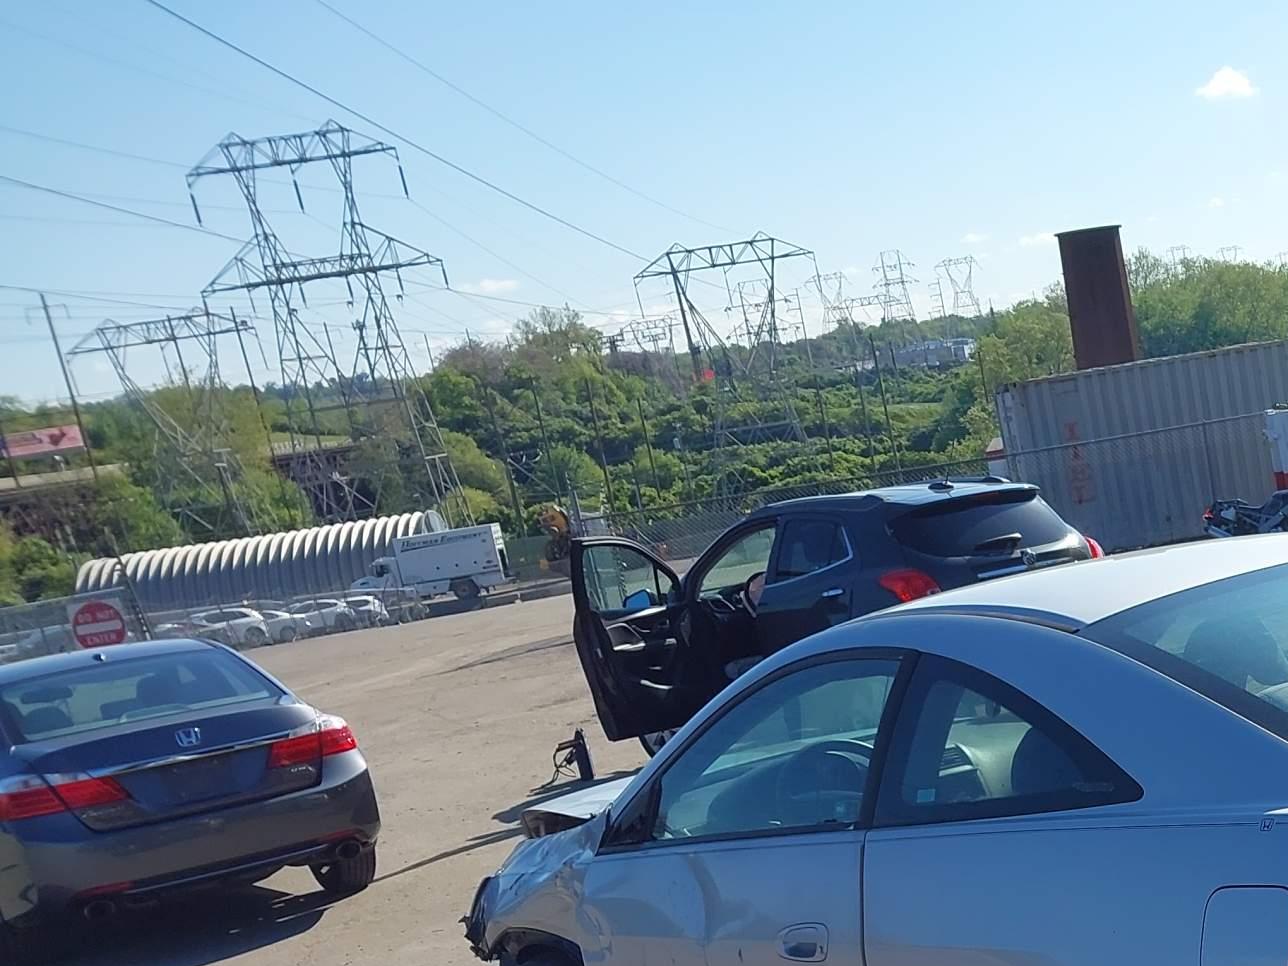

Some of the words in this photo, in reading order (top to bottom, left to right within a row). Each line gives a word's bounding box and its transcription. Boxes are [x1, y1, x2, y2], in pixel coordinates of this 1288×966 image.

[77, 613, 92, 623] DO
[96, 609, 114, 619] NOT
[87, 632, 117, 646] ENTER
